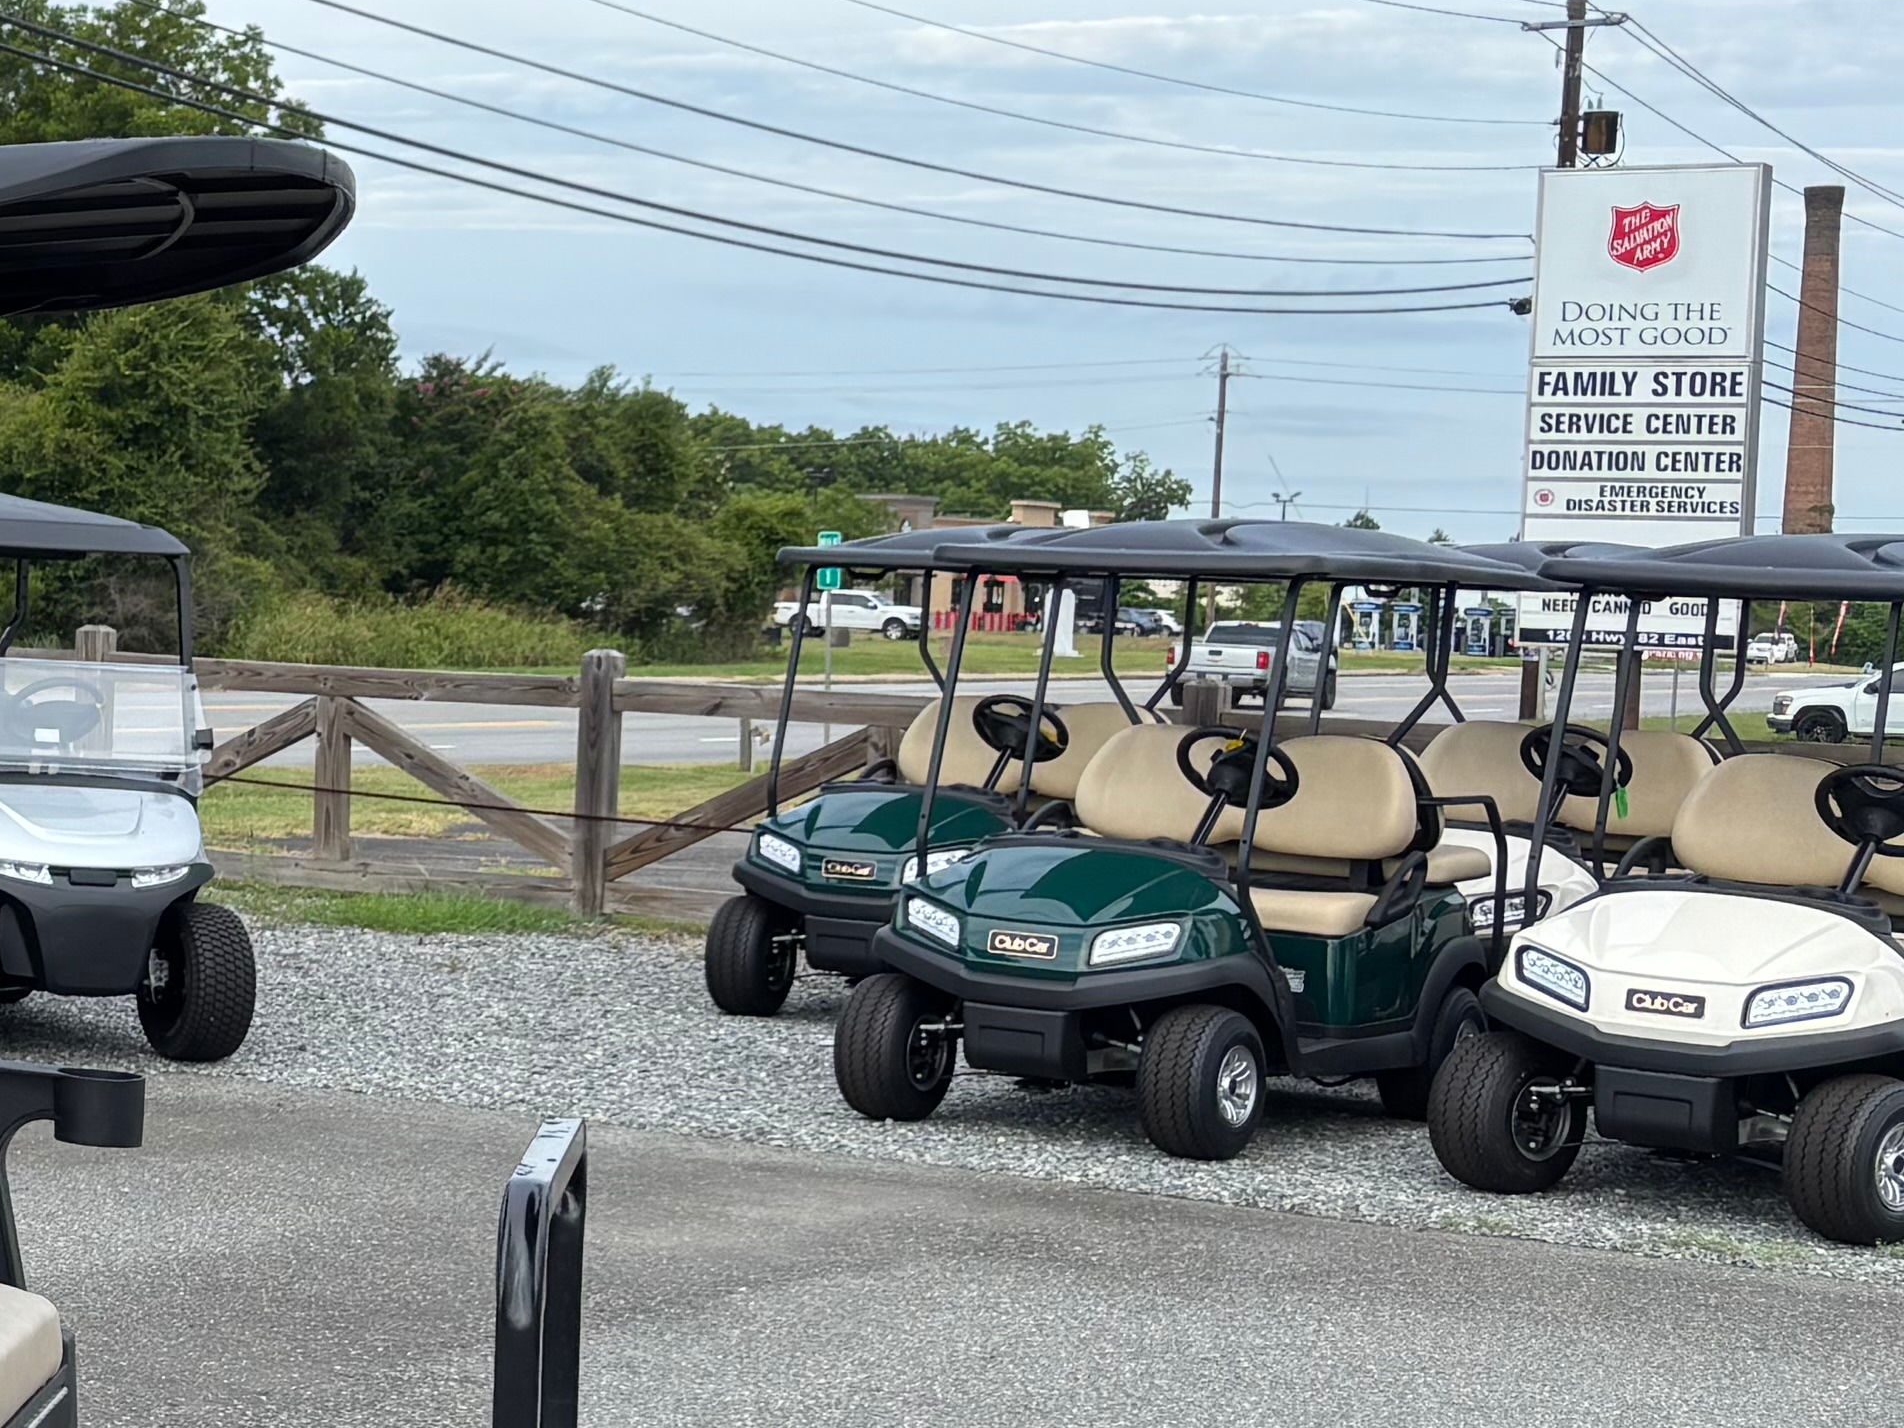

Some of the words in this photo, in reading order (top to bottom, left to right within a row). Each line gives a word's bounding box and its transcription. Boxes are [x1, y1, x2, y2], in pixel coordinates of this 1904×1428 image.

[1623, 209, 1651, 233] THE
[1612, 211, 1673, 256] SALVATION
[1633, 231, 1671, 264] ARMY
[1561, 301, 1660, 323] DOING
[1667, 302, 1722, 321] THE
[1552, 327, 1632, 346] MOST
[1638, 326, 1729, 346] GOOD
[1537, 371, 1638, 397] FAMILY
[1651, 371, 1744, 397] STORE
[1539, 413, 1634, 435] SERVICE
[1645, 413, 1737, 435] CENTER
[1531, 450, 1646, 472] DONATION
[1655, 451, 1743, 473] CENTER
[1598, 484, 1707, 499] EMERGENCY
[1565, 498, 1651, 512] DISASTER
[1655, 500, 1740, 514] SERVICES
[1592, 599, 1652, 615] CANND
[1637, 633, 1659, 644] 82
